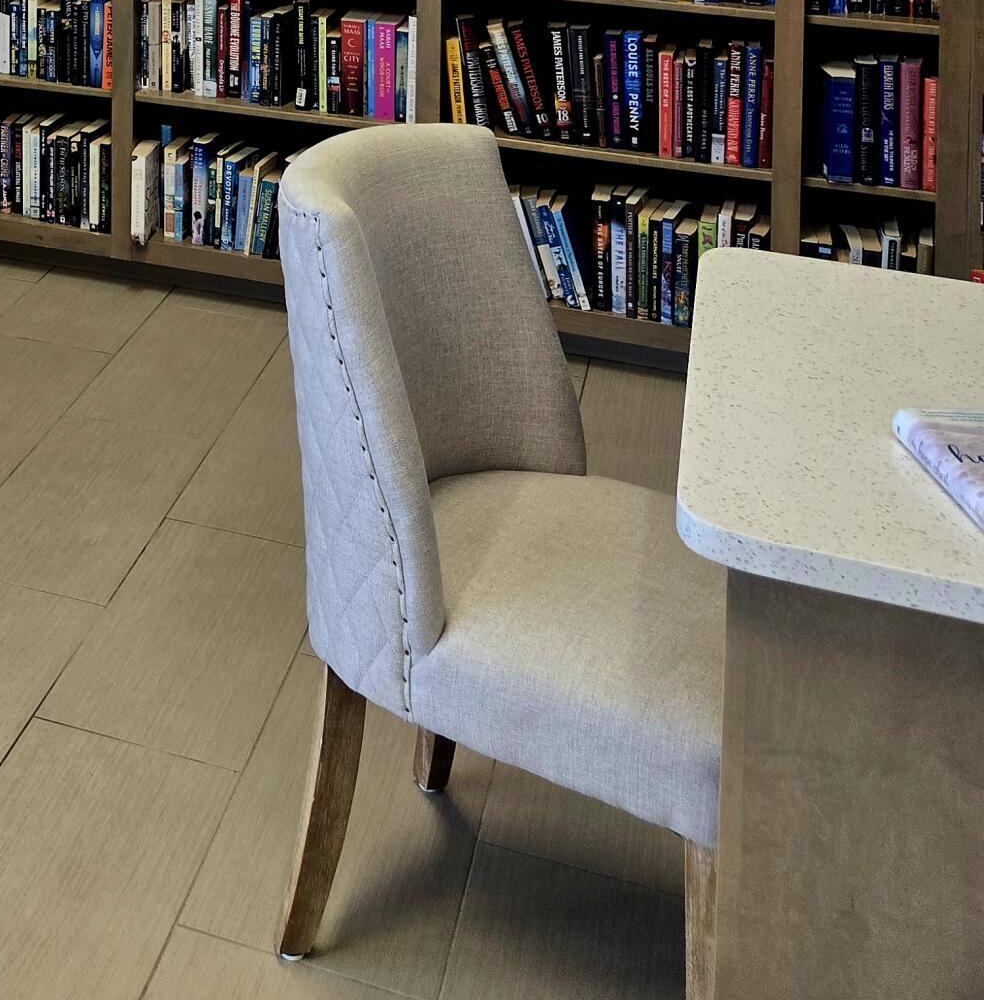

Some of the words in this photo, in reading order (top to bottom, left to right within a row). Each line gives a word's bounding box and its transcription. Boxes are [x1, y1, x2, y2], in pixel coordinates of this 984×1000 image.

[229, 12, 240, 36] BOURNE
[229, 38, 240, 71] EVOLUTION
[549, 31, 562, 55] JAMES
[628, 38, 638, 77] LOUISE
[730, 50, 740, 71] ANNE
[748, 53, 757, 77] ANNE
[553, 57, 564, 101] PATTERSON
[729, 73, 740, 98] PERRY
[748, 79, 757, 104] PERRY
[629, 93, 639, 131] PENNY
[224, 165, 232, 206] DEVOTION
[263, 189, 273, 211] SUSAN
[259, 212, 270, 242] MALLERY
[615, 229, 623, 246] THE
[615, 250, 623, 270] FALL
